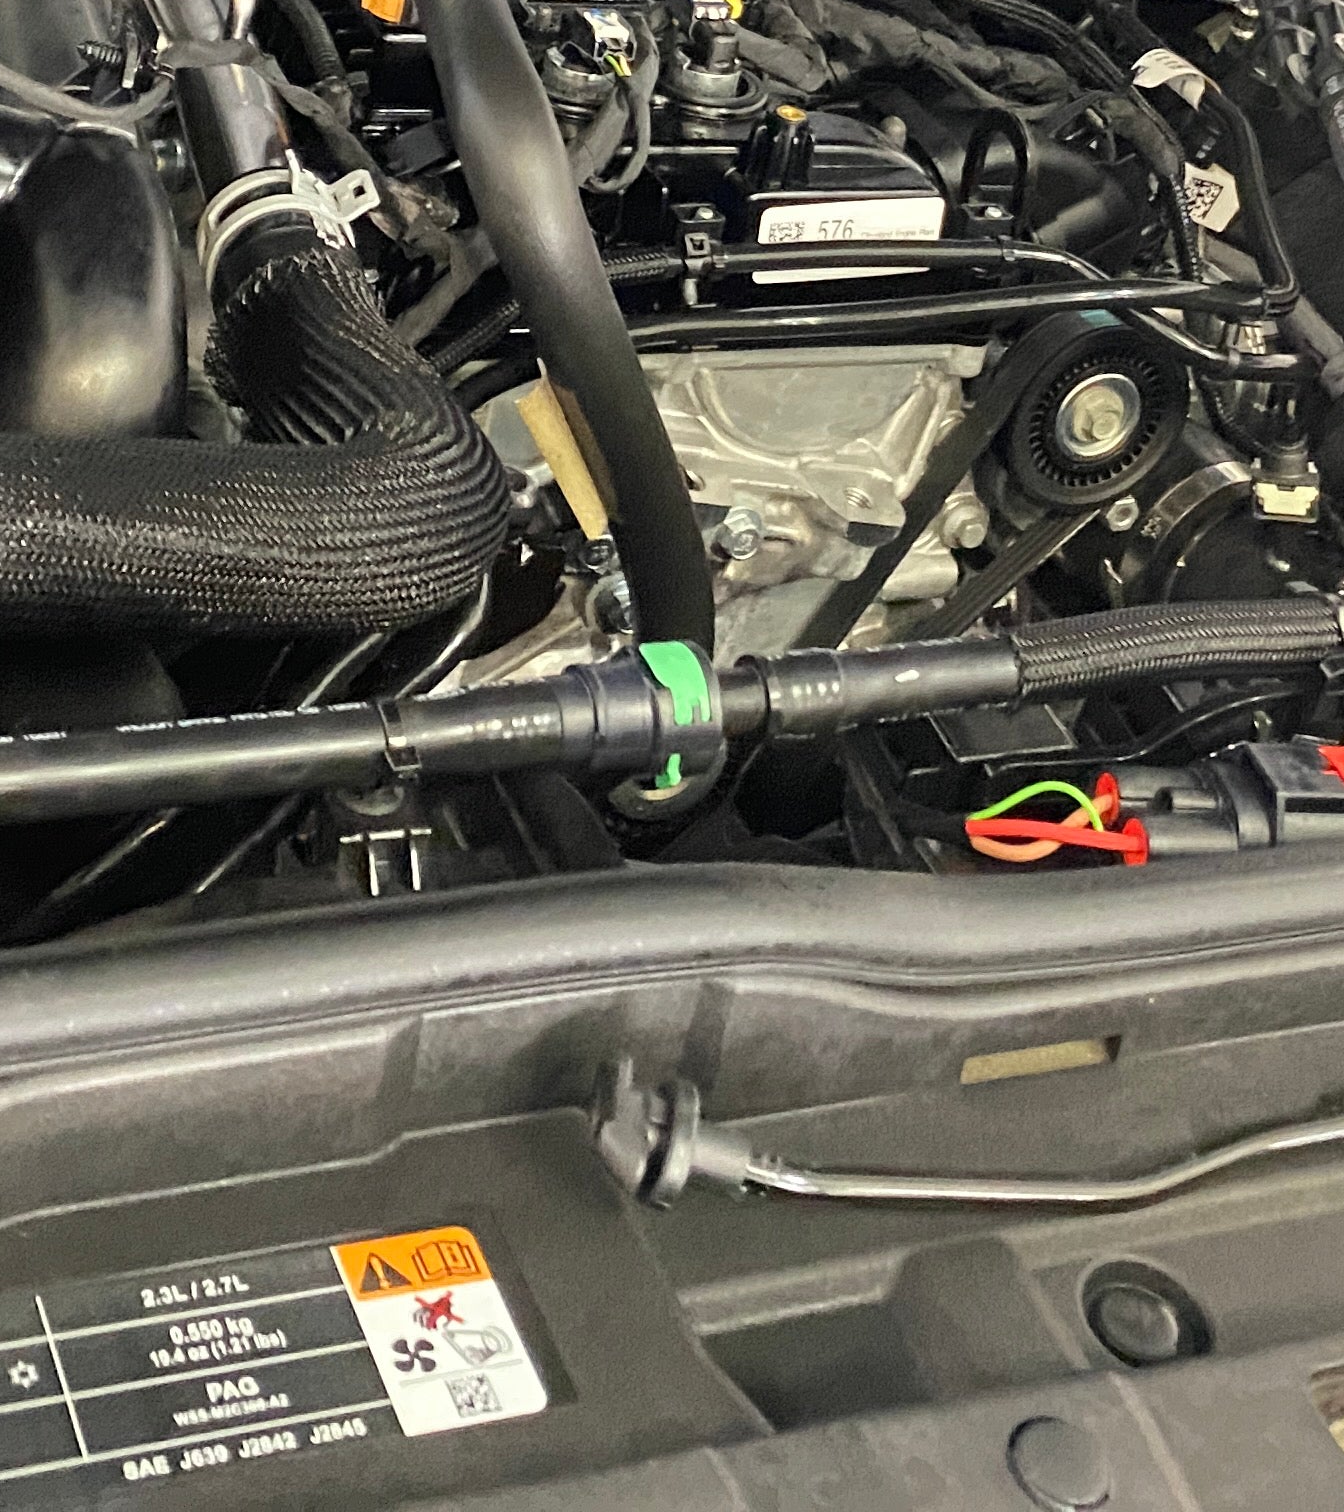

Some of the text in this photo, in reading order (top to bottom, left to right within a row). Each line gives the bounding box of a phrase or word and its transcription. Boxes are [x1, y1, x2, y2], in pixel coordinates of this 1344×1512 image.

[817, 219, 855, 239] 576
[141, 1284, 189, 1308] 2.3L
[202, 1273, 250, 1298] 2.7L
[223, 1317, 254, 1341] kg
[206, 1377, 259, 1403] PAG
[123, 1456, 171, 1481] SAE
